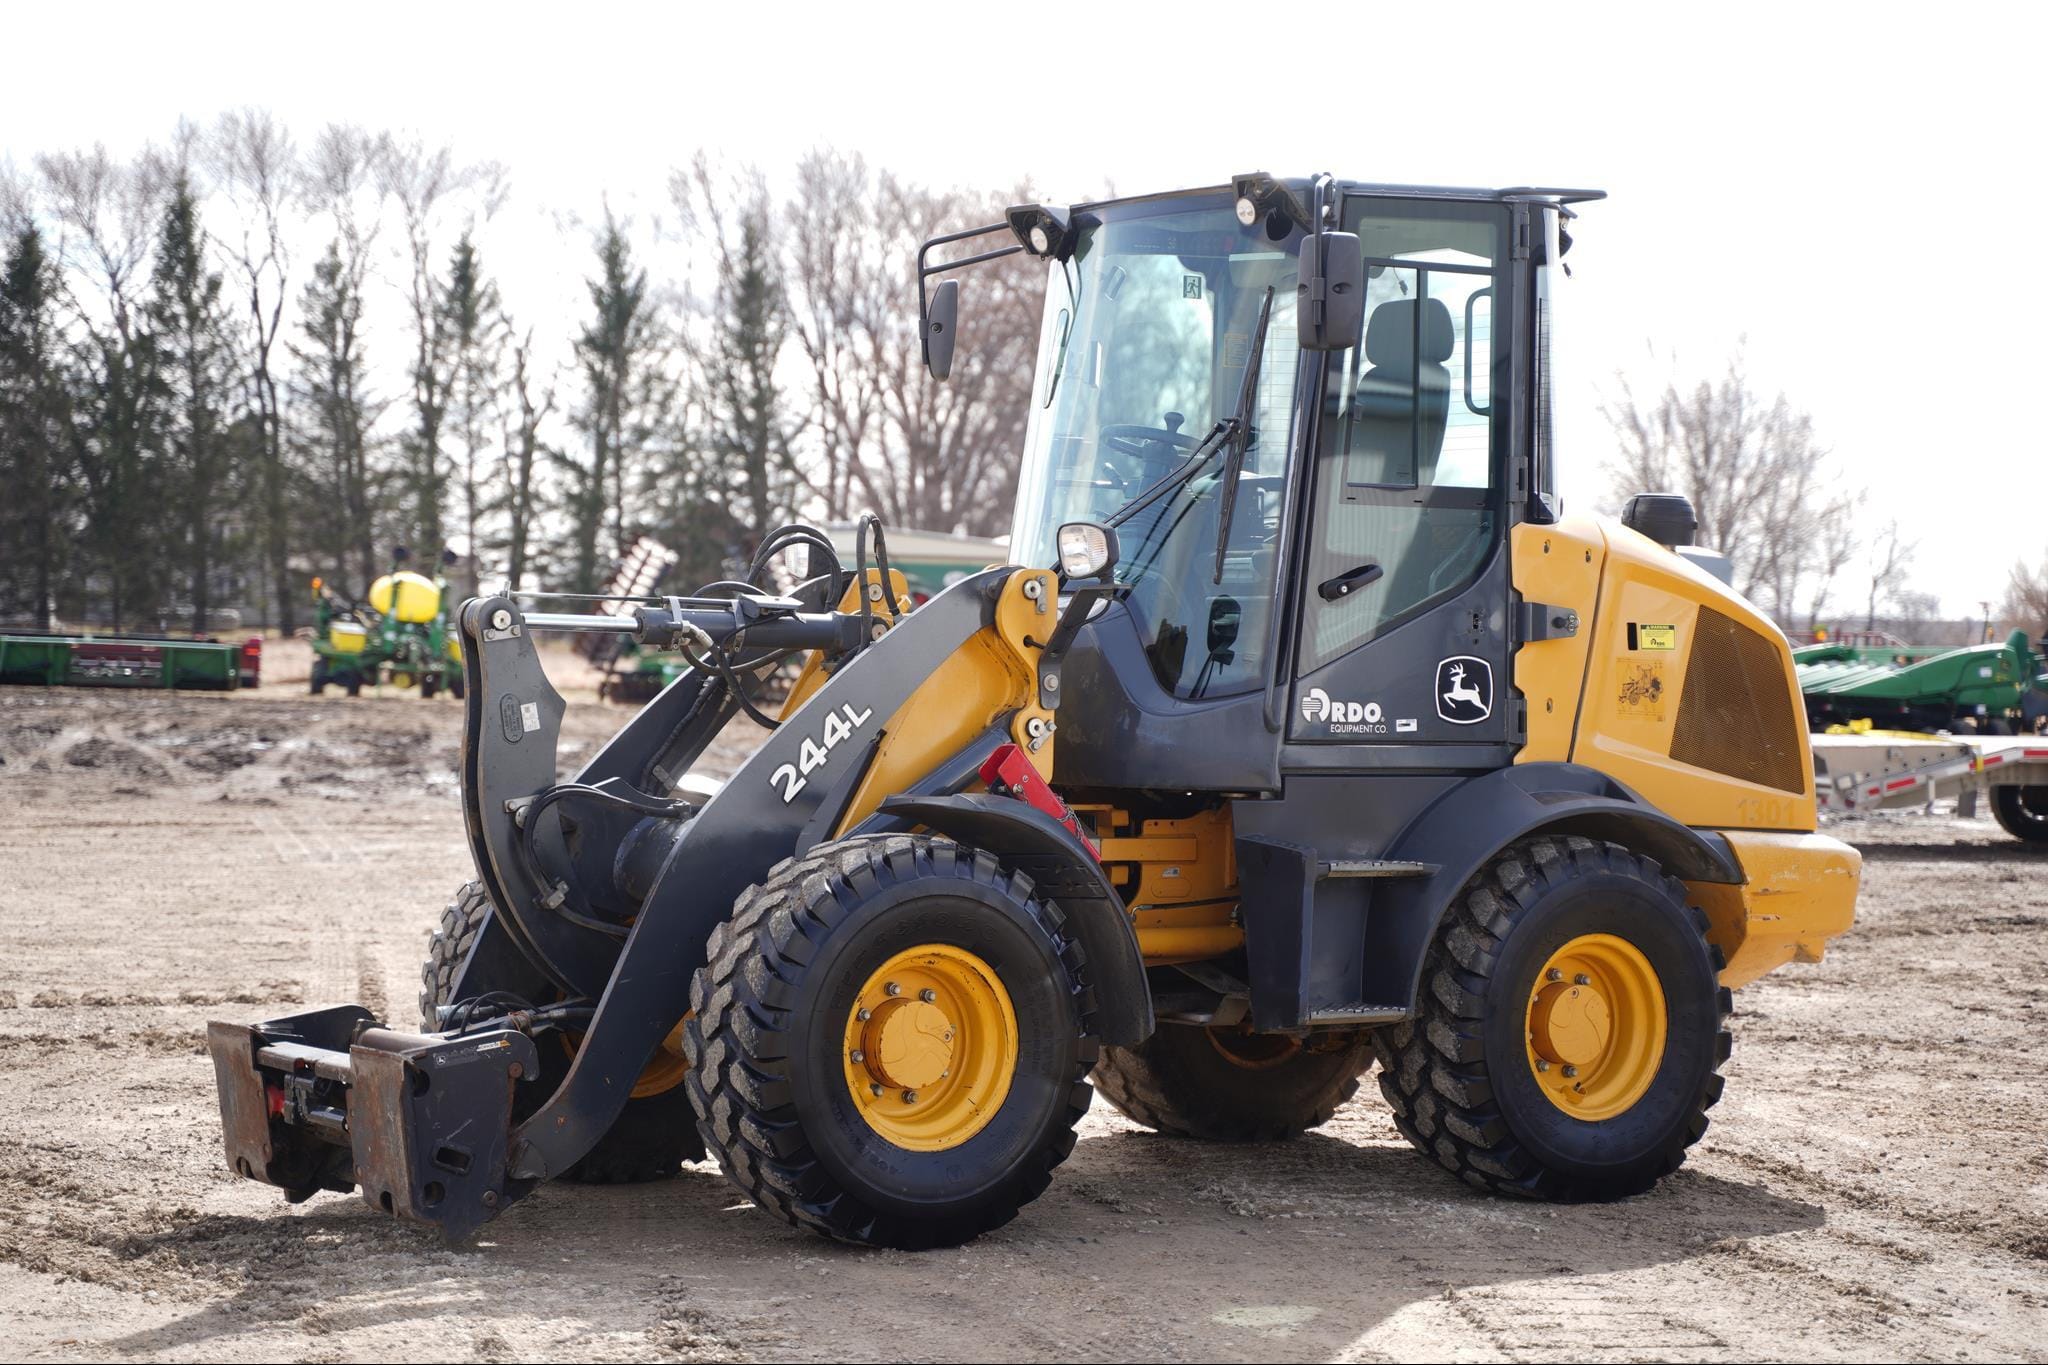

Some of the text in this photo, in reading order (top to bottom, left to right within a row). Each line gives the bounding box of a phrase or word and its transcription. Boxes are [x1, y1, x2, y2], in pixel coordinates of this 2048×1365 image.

[1330, 724, 1373, 733] EQUIPMENT
[1374, 724, 1388, 734] CO.
[769, 703, 873, 803] 244L
[1737, 798, 1796, 825] 1301
